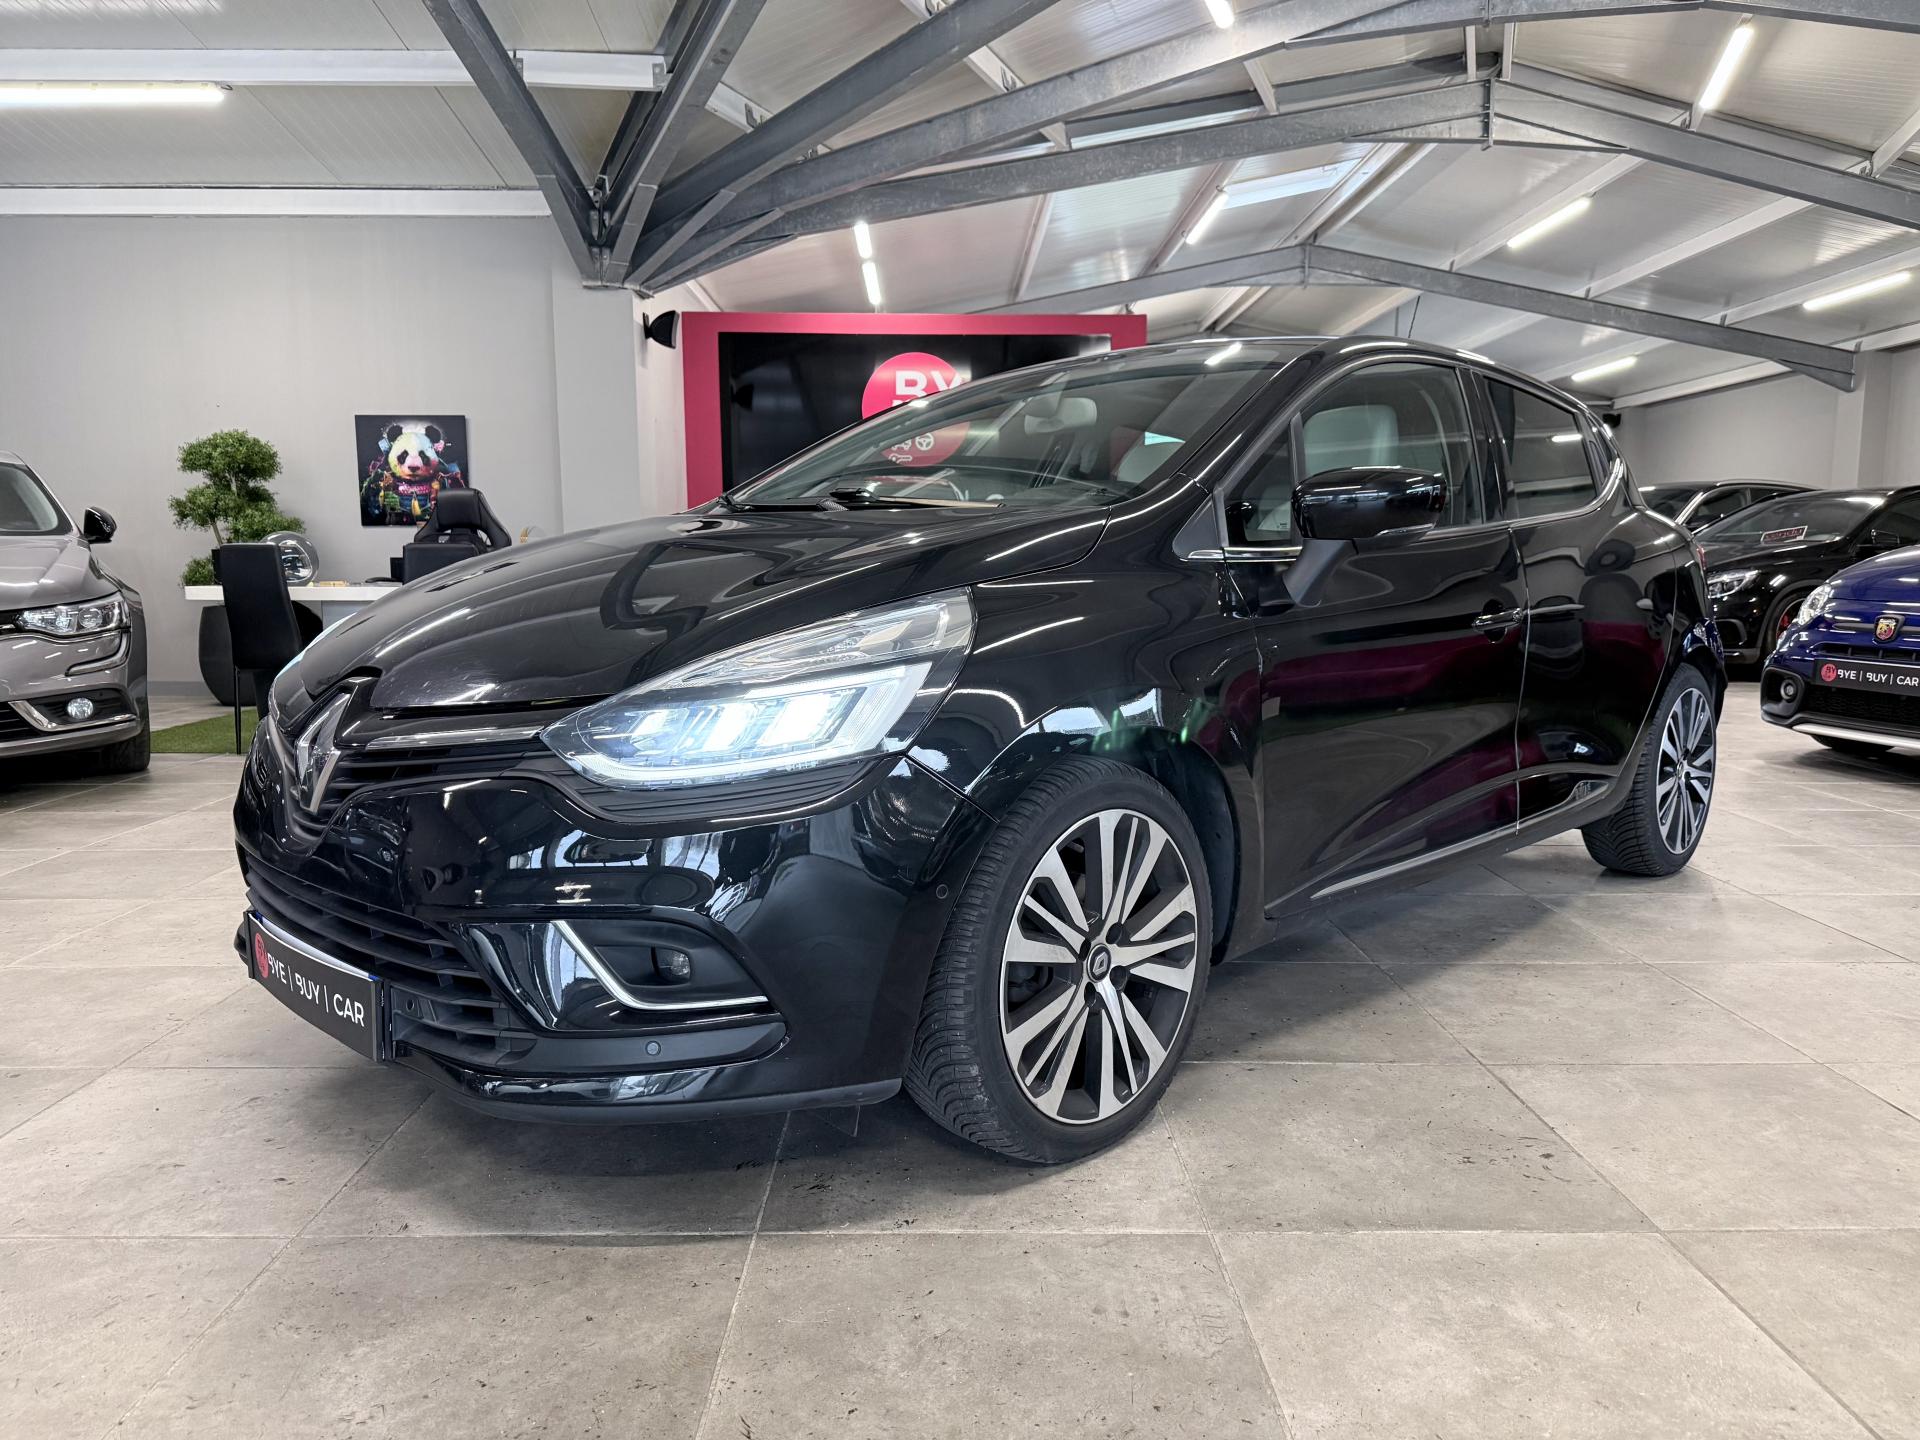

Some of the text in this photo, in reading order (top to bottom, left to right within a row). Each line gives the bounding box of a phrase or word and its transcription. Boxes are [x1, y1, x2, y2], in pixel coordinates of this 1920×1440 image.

[1837, 669, 1857, 680] BYE
[1866, 672, 1888, 682] BUY
[1896, 676, 1919, 687] CAR
[268, 952, 287, 984] BYE
[295, 973, 319, 1004] BUY
[334, 994, 364, 1027] CAR
